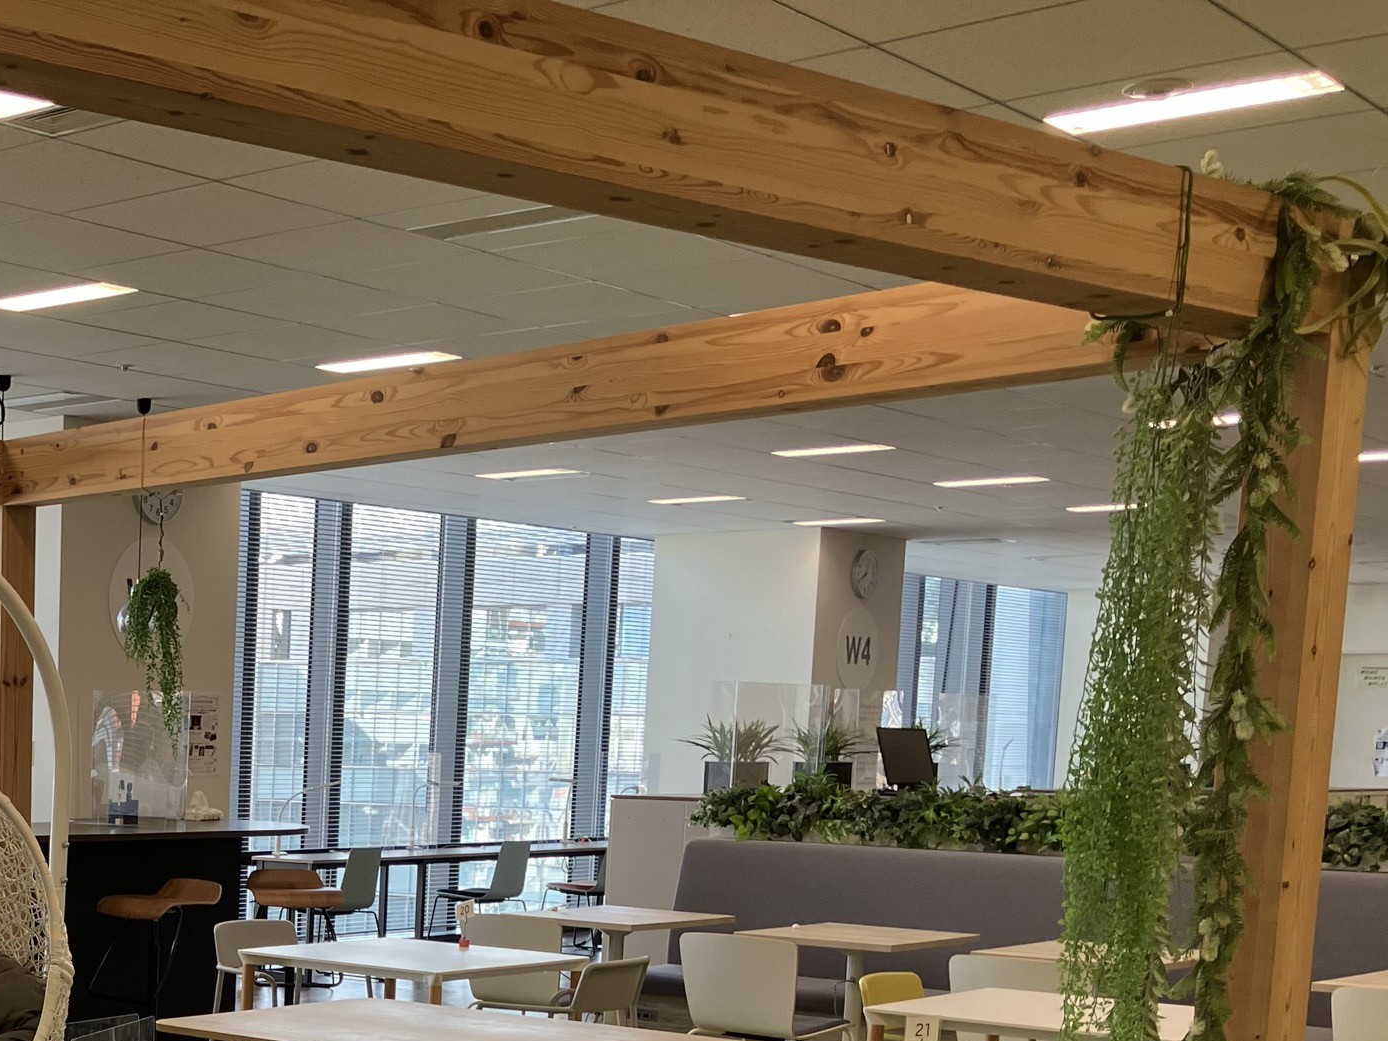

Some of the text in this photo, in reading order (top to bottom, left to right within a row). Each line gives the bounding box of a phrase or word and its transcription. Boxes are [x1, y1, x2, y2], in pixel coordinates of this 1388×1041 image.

[845, 635, 871, 666] W4
[460, 904, 470, 916] 20
[915, 1023, 930, 1037] 21
